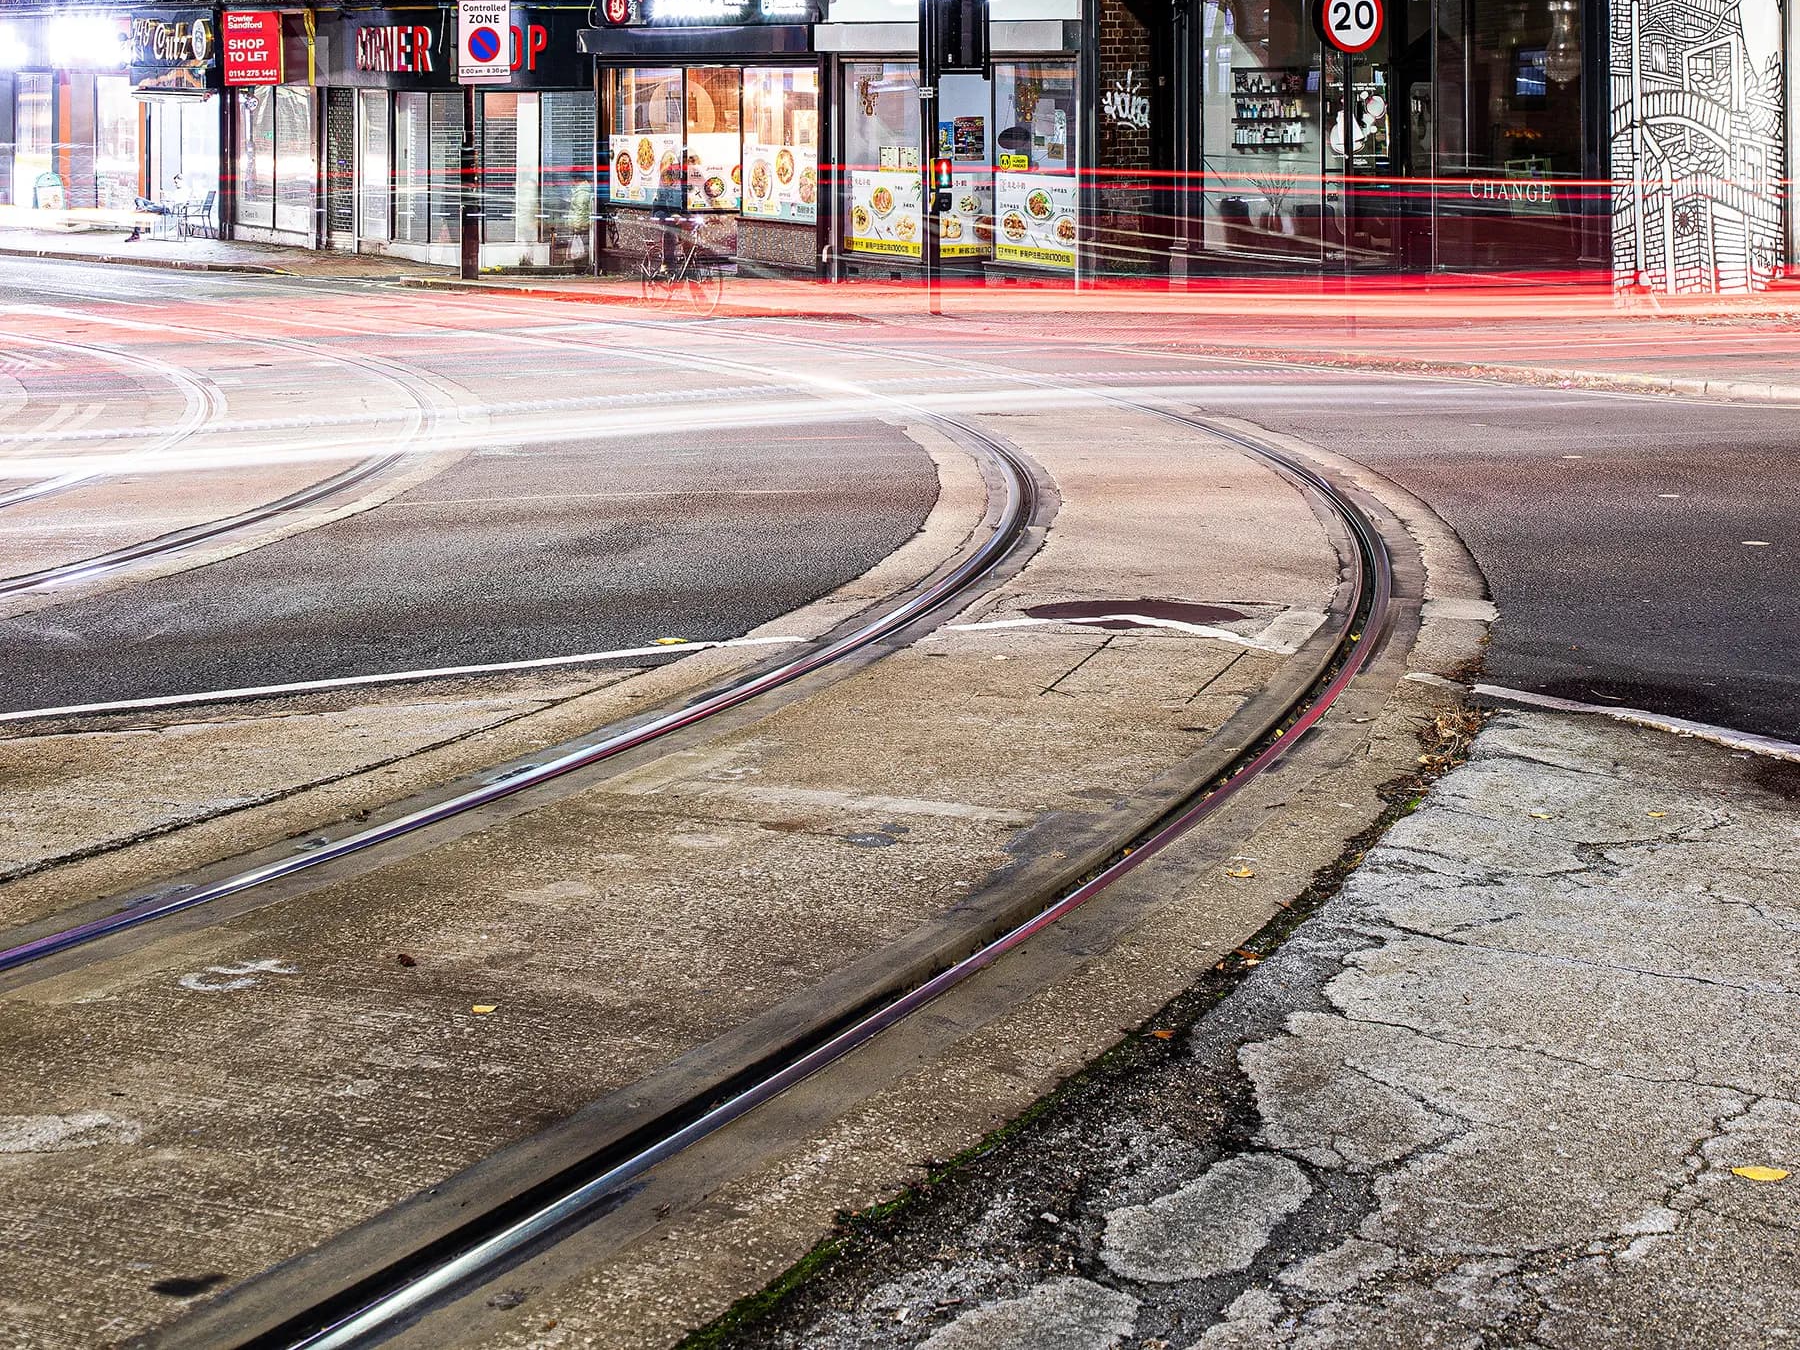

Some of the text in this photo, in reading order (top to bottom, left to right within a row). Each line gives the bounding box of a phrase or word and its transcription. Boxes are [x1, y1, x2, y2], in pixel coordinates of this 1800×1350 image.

[462, 3, 507, 12] Controlled
[227, 14, 254, 23] Fowler
[468, 14, 500, 24] ZONE
[1333, 0, 1374, 31] 20
[228, 38, 265, 50] SHOP
[355, 25, 433, 72] CORNER
[228, 51, 269, 62] TO LET
[228, 69, 245, 77] 0114
[1469, 178, 1553, 203] CHANGE
